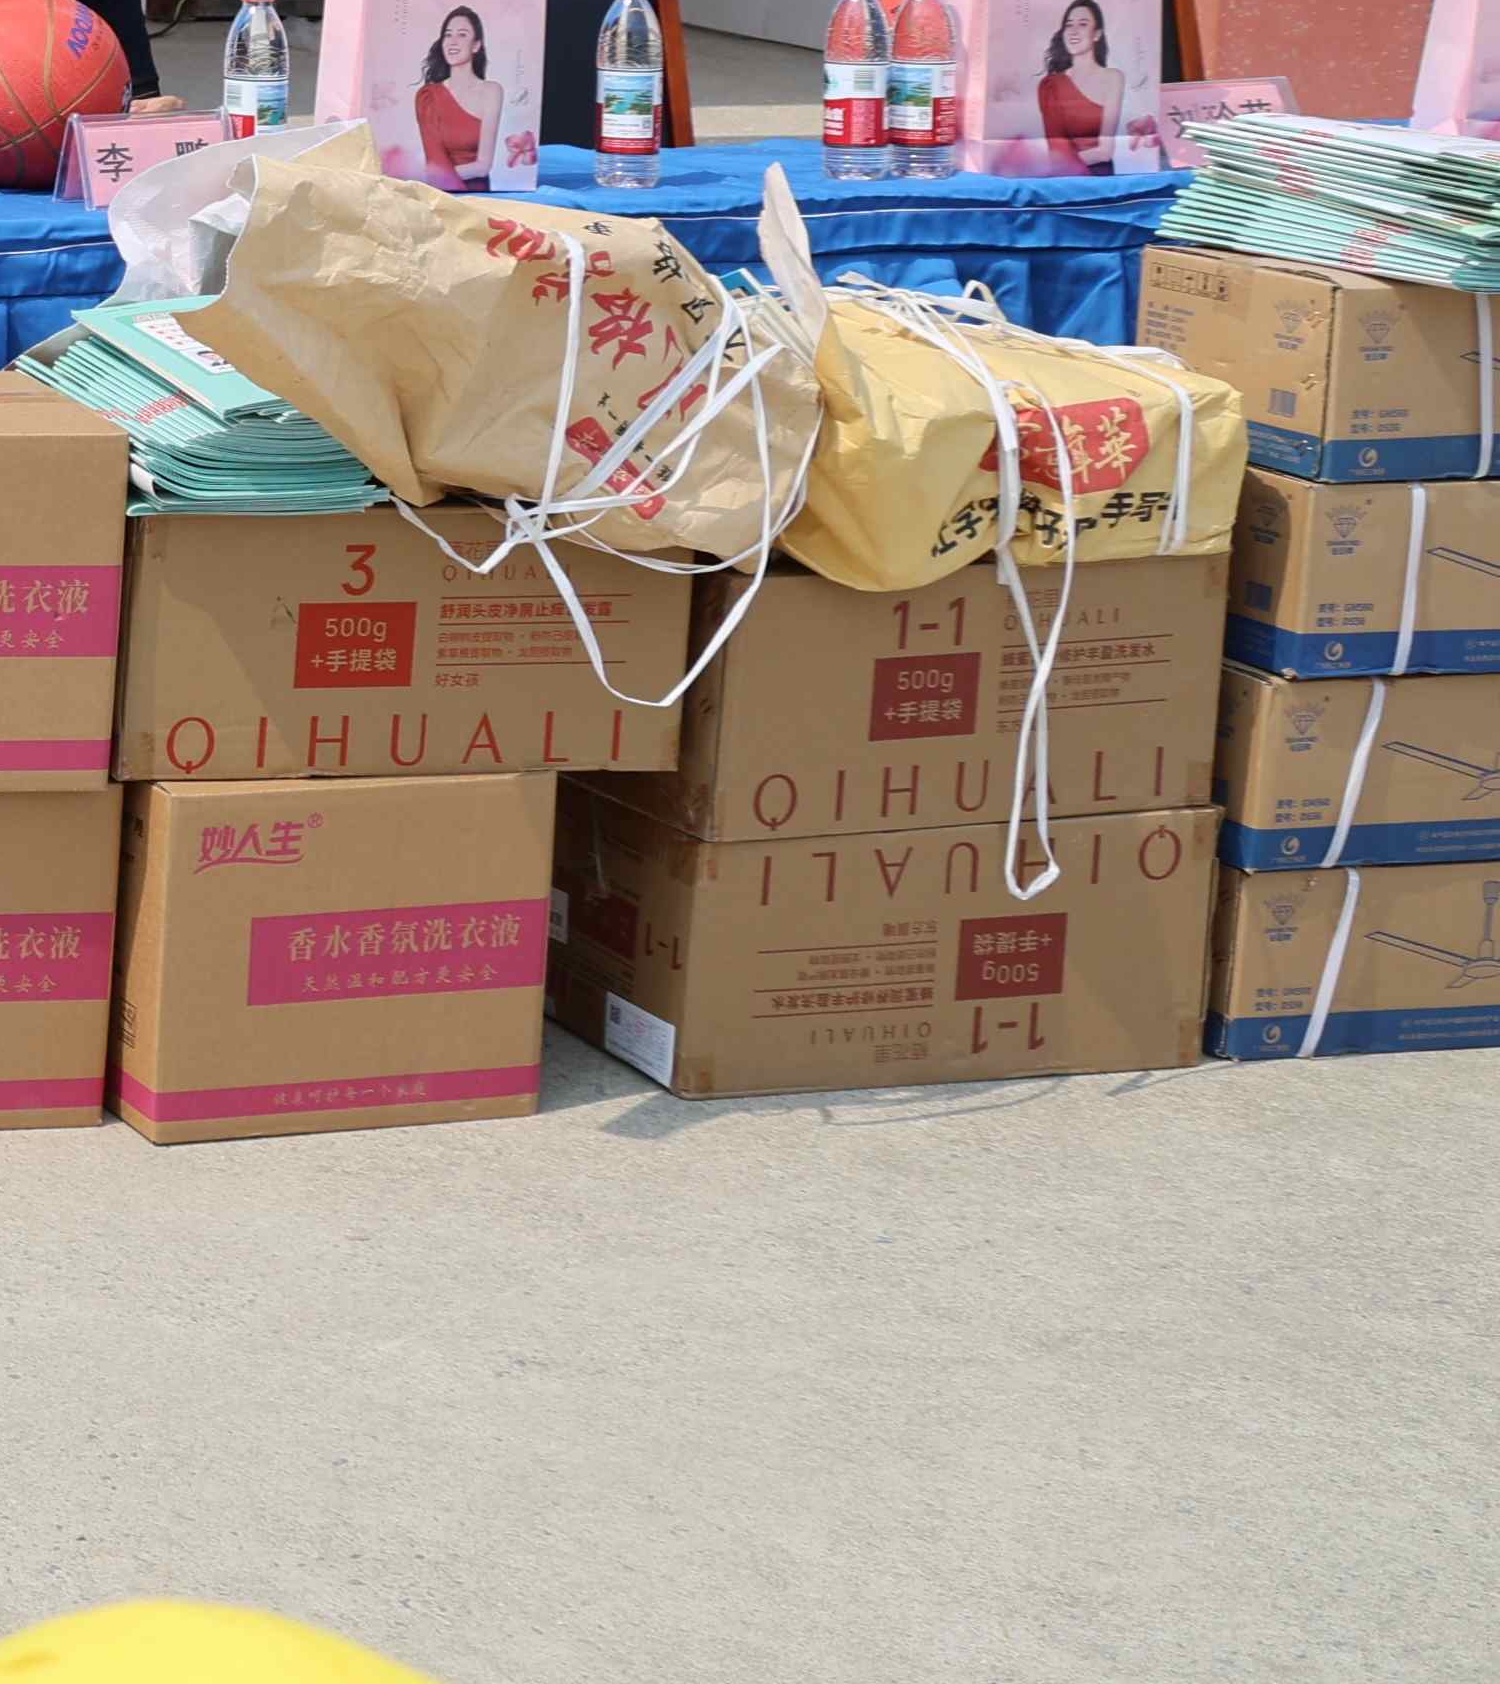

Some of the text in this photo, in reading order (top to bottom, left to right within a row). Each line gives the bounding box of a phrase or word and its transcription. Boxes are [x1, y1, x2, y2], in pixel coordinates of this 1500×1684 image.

[342, 544, 376, 595] 3
[325, 618, 387, 642] 500g
[894, 596, 965, 649] 1-1
[311, 648, 397, 672] +手提袋
[898, 670, 954, 693] 500g
[884, 699, 963, 724] +手提袋
[165, 712, 621, 775] QIHUALI
[284, 914, 524, 964] 香水香氛洗衣液
[973, 930, 1052, 955] +手提袋
[299, 964, 501, 995] 天然温和配方更安全
[983, 961, 1040, 983] 500g
[972, 1002, 1044, 1054] 1-1
